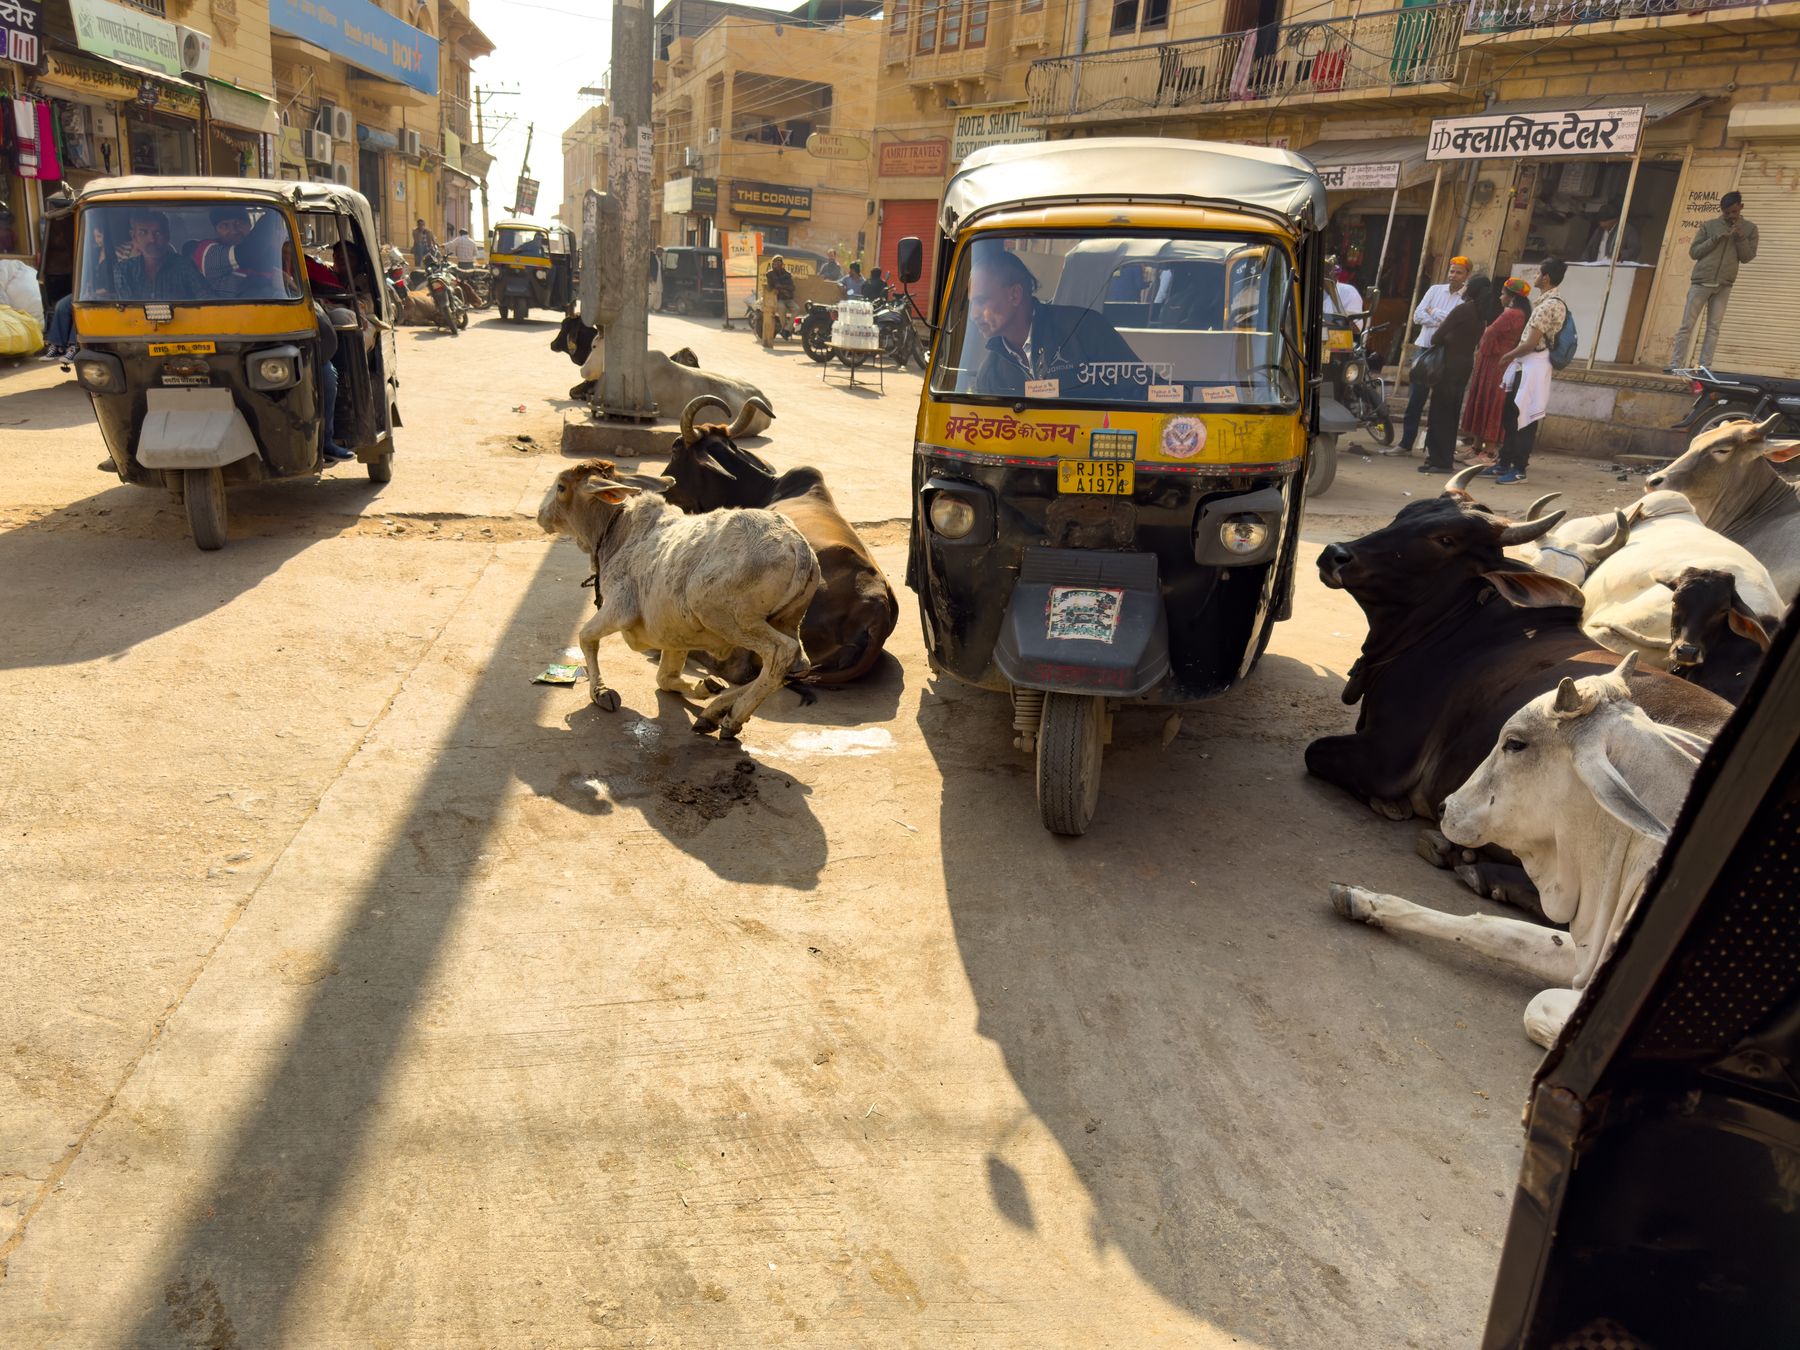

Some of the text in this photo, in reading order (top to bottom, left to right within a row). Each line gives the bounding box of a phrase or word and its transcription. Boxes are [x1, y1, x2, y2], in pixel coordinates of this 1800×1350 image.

[344, 18, 388, 56] Bank of India
[392, 38, 411, 71] BOI
[957, 114, 985, 137] HOTEL
[988, 112, 1021, 135] SHANTI
[1452, 116, 1560, 153] क्लासिक
[886, 145, 941, 158] AMRIT TRAVELS
[737, 190, 809, 207] THE CORNER
[1689, 191, 1720, 201] FORMAL
[1018, 423, 1036, 439] की
[1035, 423, 1081, 446] जय
[1076, 462, 1125, 478] RJ15P
[1076, 478, 1125, 493] A1974
